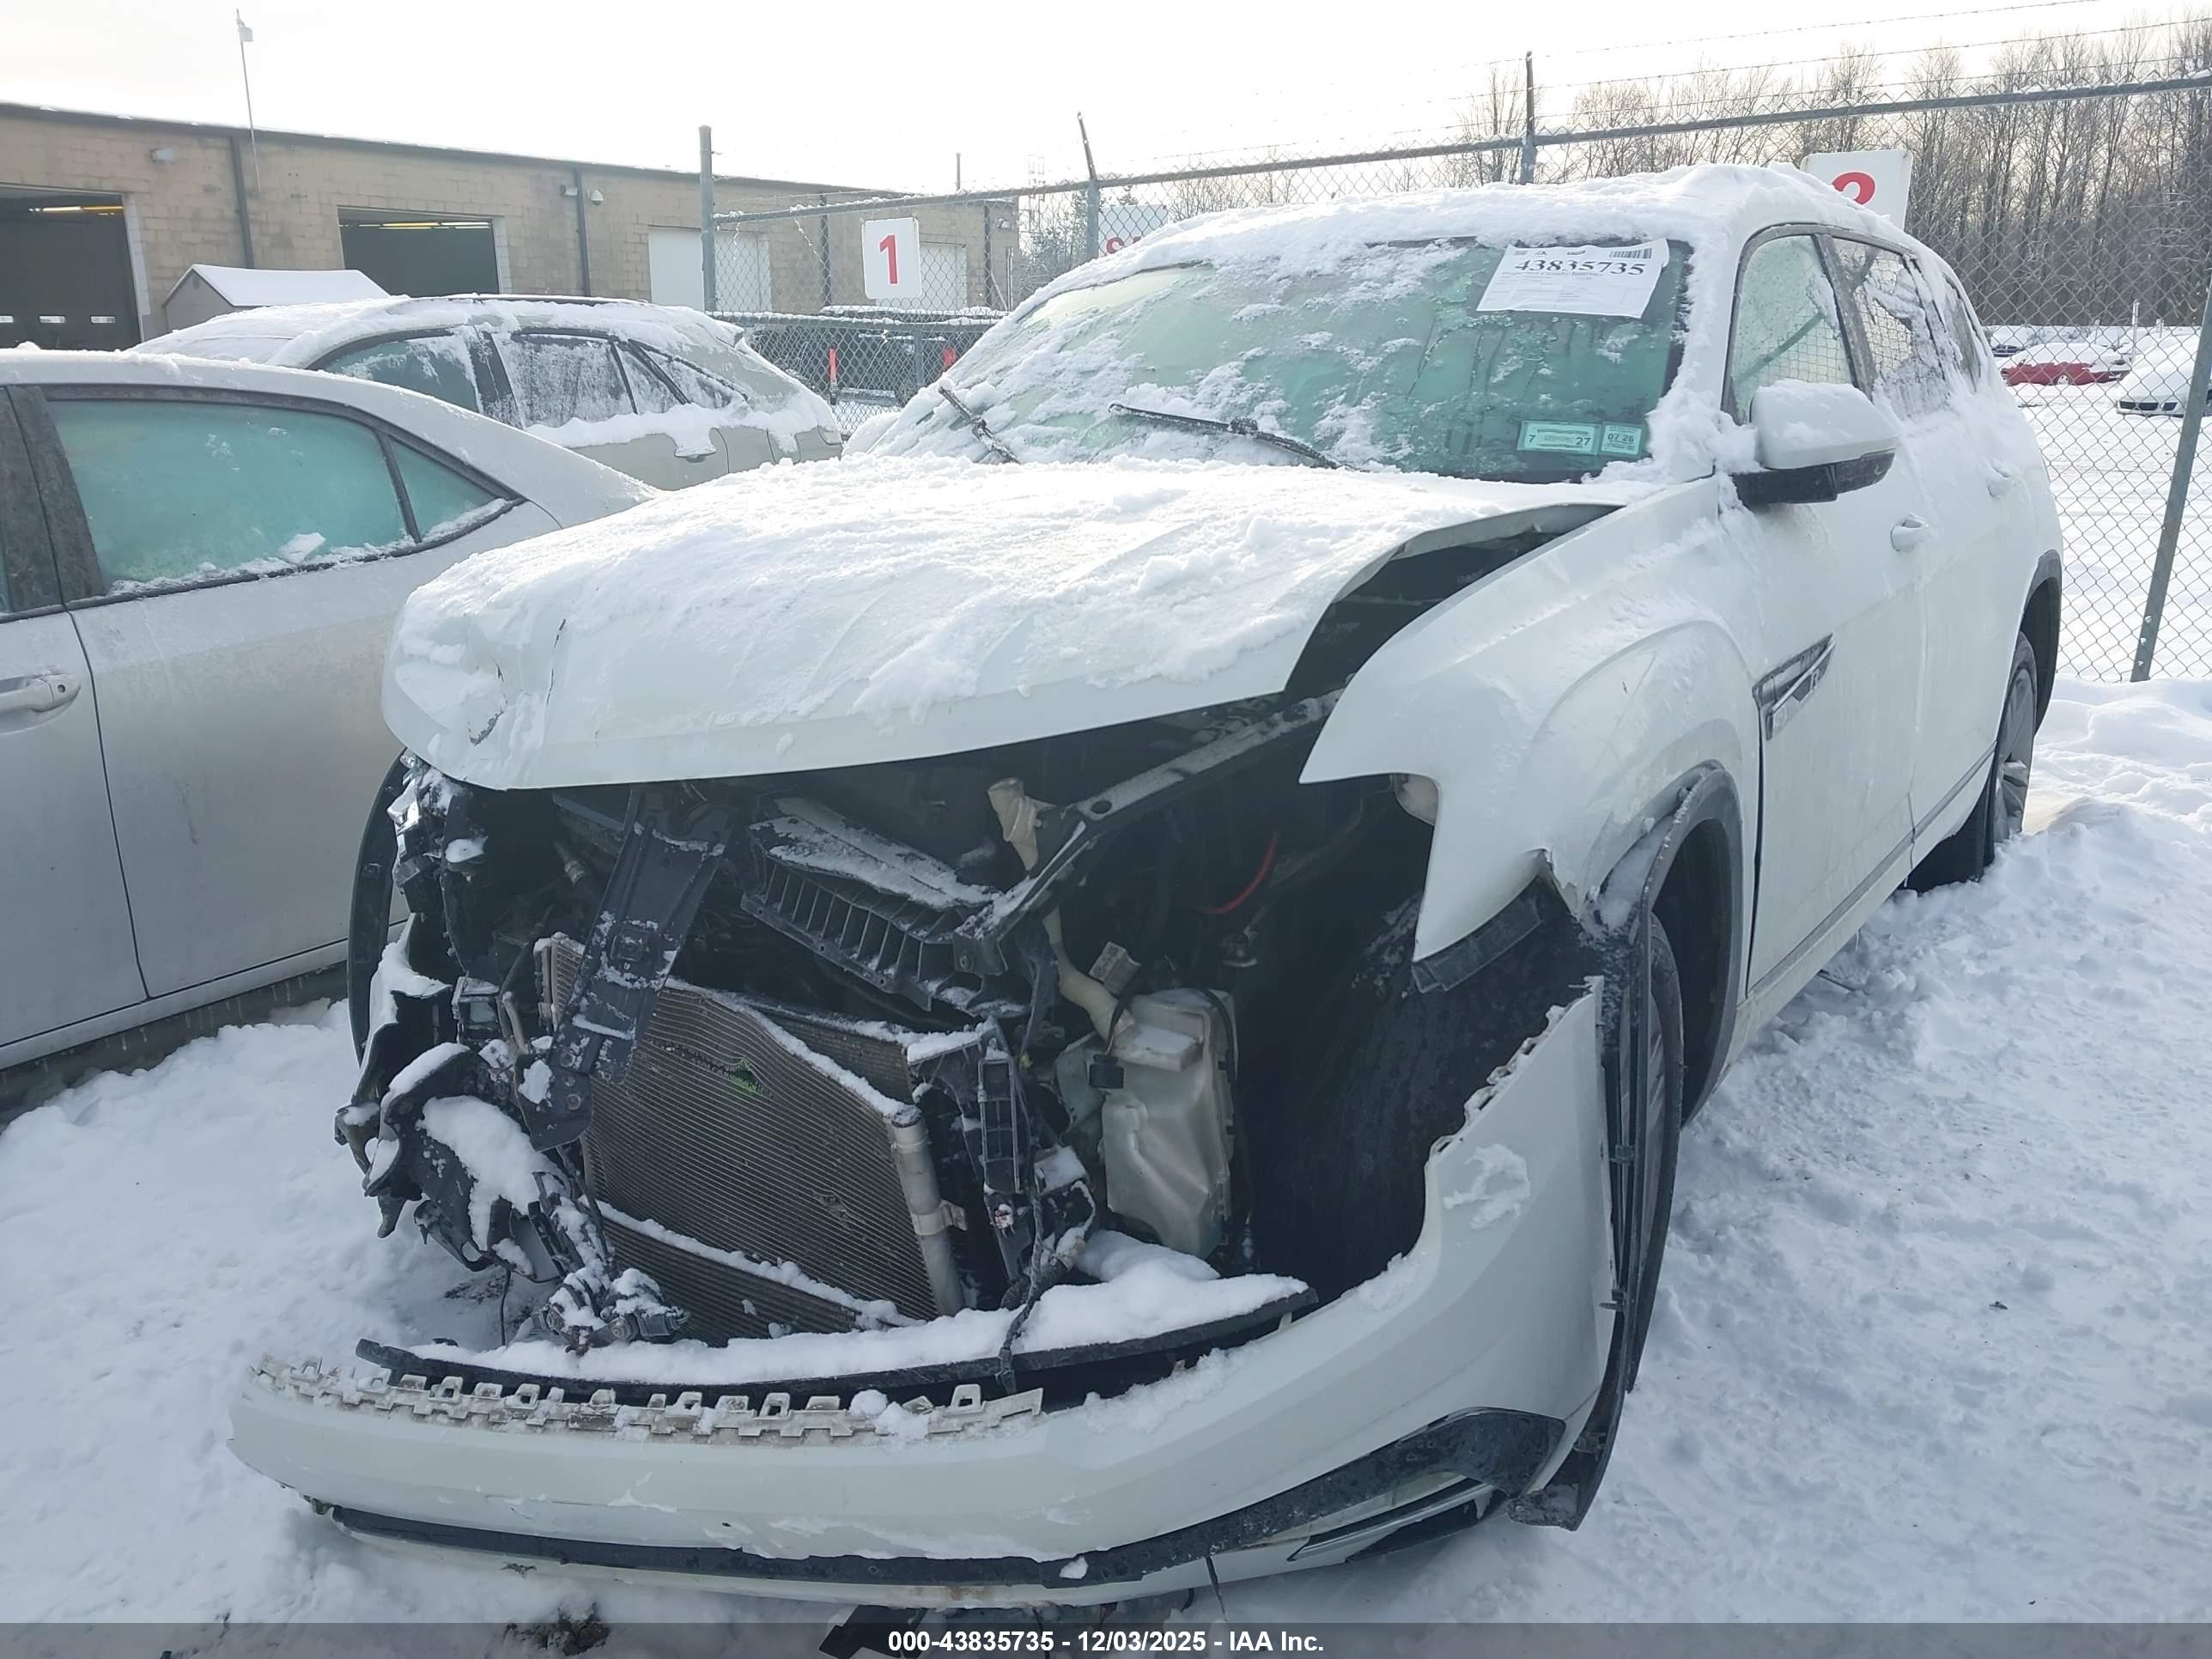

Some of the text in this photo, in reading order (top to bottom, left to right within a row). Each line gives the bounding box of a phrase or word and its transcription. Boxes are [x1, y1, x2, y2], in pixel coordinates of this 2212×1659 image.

[879, 233, 898, 285] 1
[1515, 259, 1646, 275] 43835735
[1528, 434, 1536, 444] 7
[1576, 436, 1591, 447] 27
